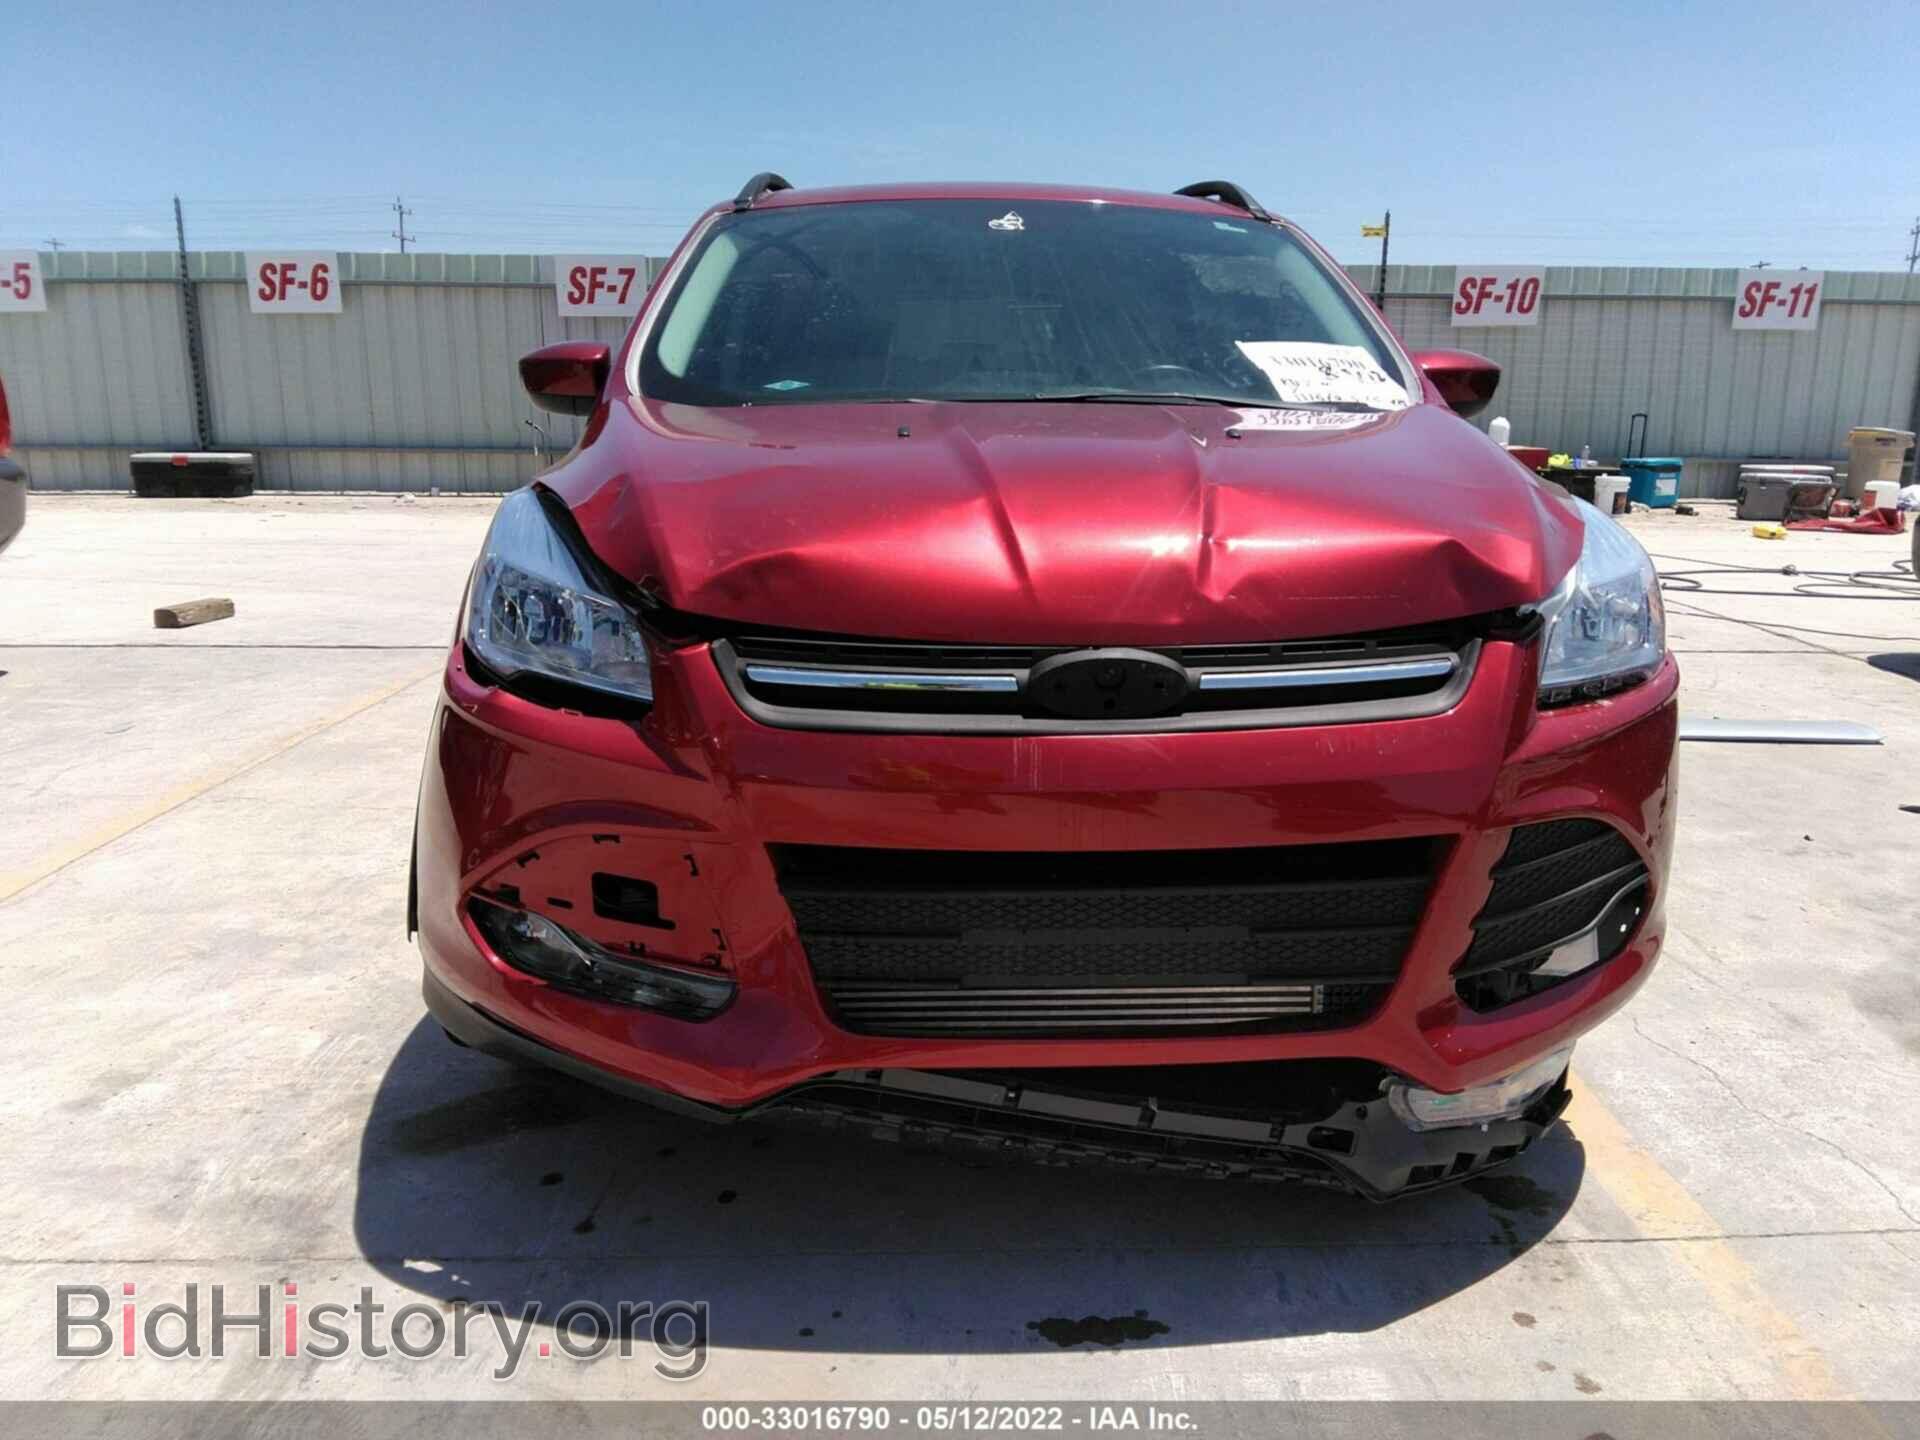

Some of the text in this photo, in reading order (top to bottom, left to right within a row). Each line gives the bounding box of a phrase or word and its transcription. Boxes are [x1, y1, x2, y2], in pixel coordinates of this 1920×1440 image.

[0, 263, 31, 300] -5
[258, 262, 329, 302] SF-6
[567, 265, 637, 305] SF-7
[1454, 276, 1541, 315] SF-10
[1738, 280, 1818, 319] SF-11
